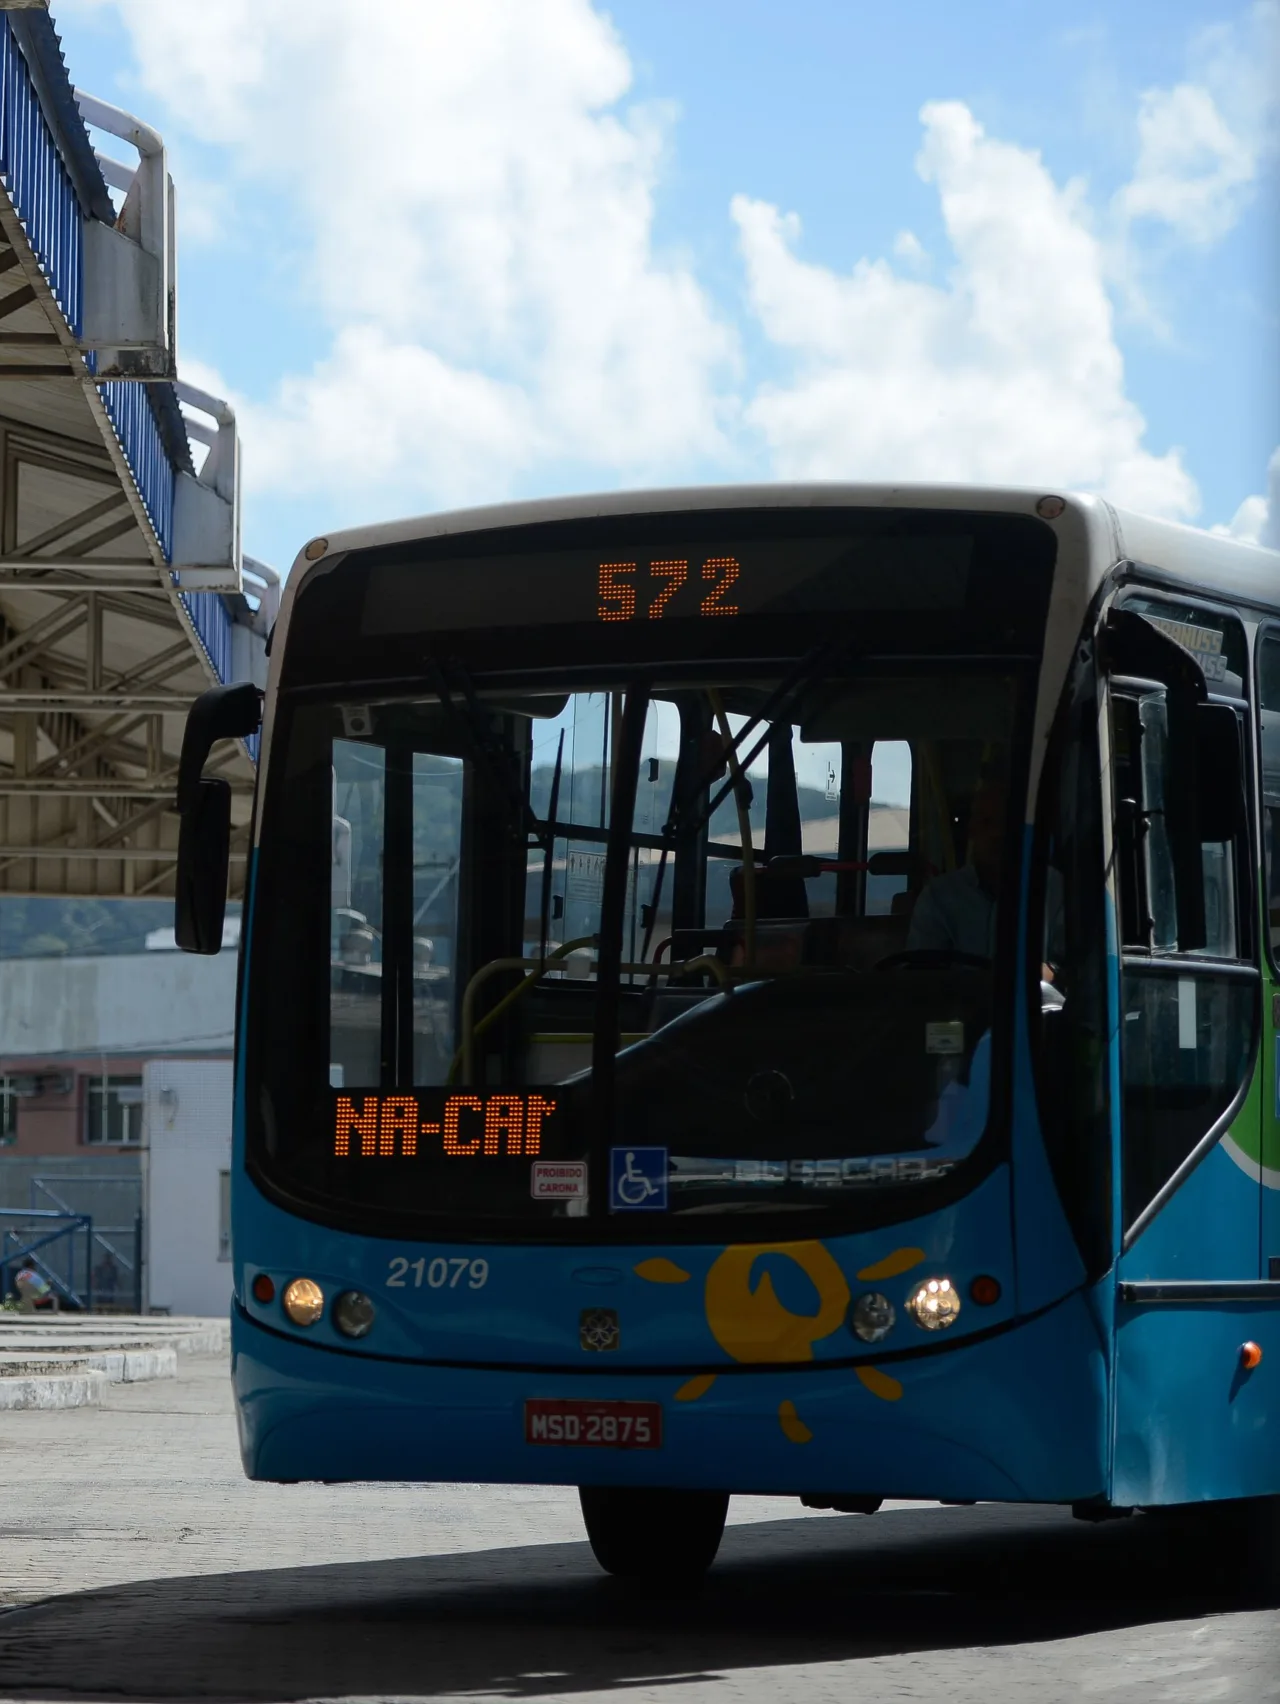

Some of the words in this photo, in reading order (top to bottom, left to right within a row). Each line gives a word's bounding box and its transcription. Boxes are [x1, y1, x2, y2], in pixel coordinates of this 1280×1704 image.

[597, 557, 740, 621] 572
[536, 1167, 583, 1178] PROIBIDO
[539, 1183, 579, 1193] CARONA
[385, 1257, 489, 1289] 21079
